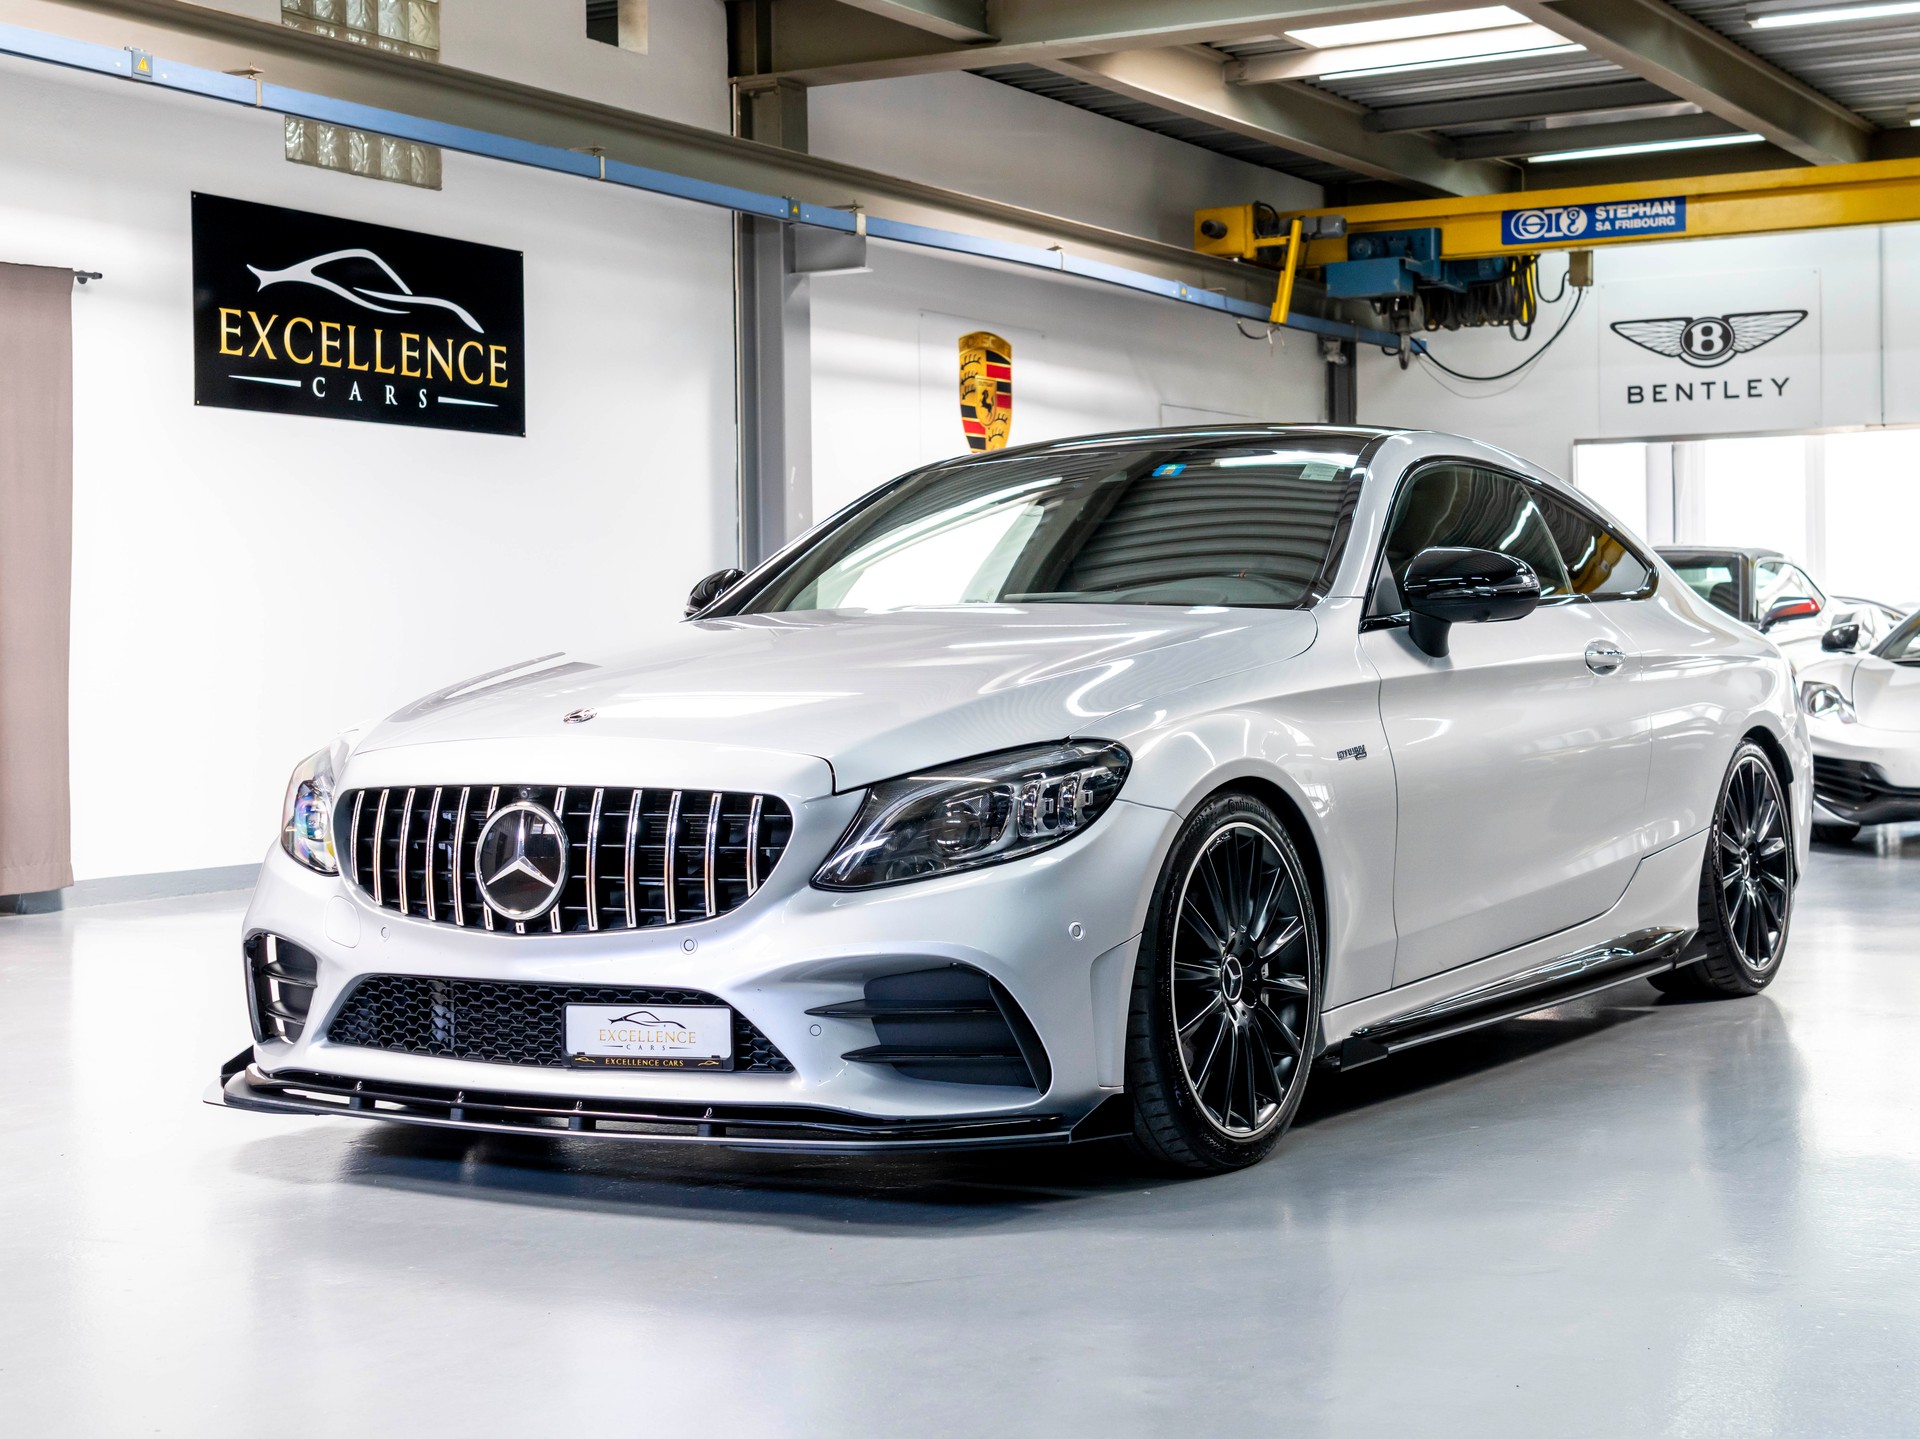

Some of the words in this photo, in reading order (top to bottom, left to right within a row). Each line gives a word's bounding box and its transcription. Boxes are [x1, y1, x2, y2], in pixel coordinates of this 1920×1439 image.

[1595, 200, 1676, 220] STEPHAN
[1595, 222, 1612, 232] SA
[1615, 216, 1676, 230] FRIBOURG
[218, 307, 509, 388] EXCELLENCE
[312, 376, 427, 408] CARS
[1627, 377, 1789, 404] BENTLEY
[599, 1029, 697, 1044] EXCELLENCE
[605, 1057, 660, 1067] EXCELLENCE
[662, 1059, 684, 1067] CARS
